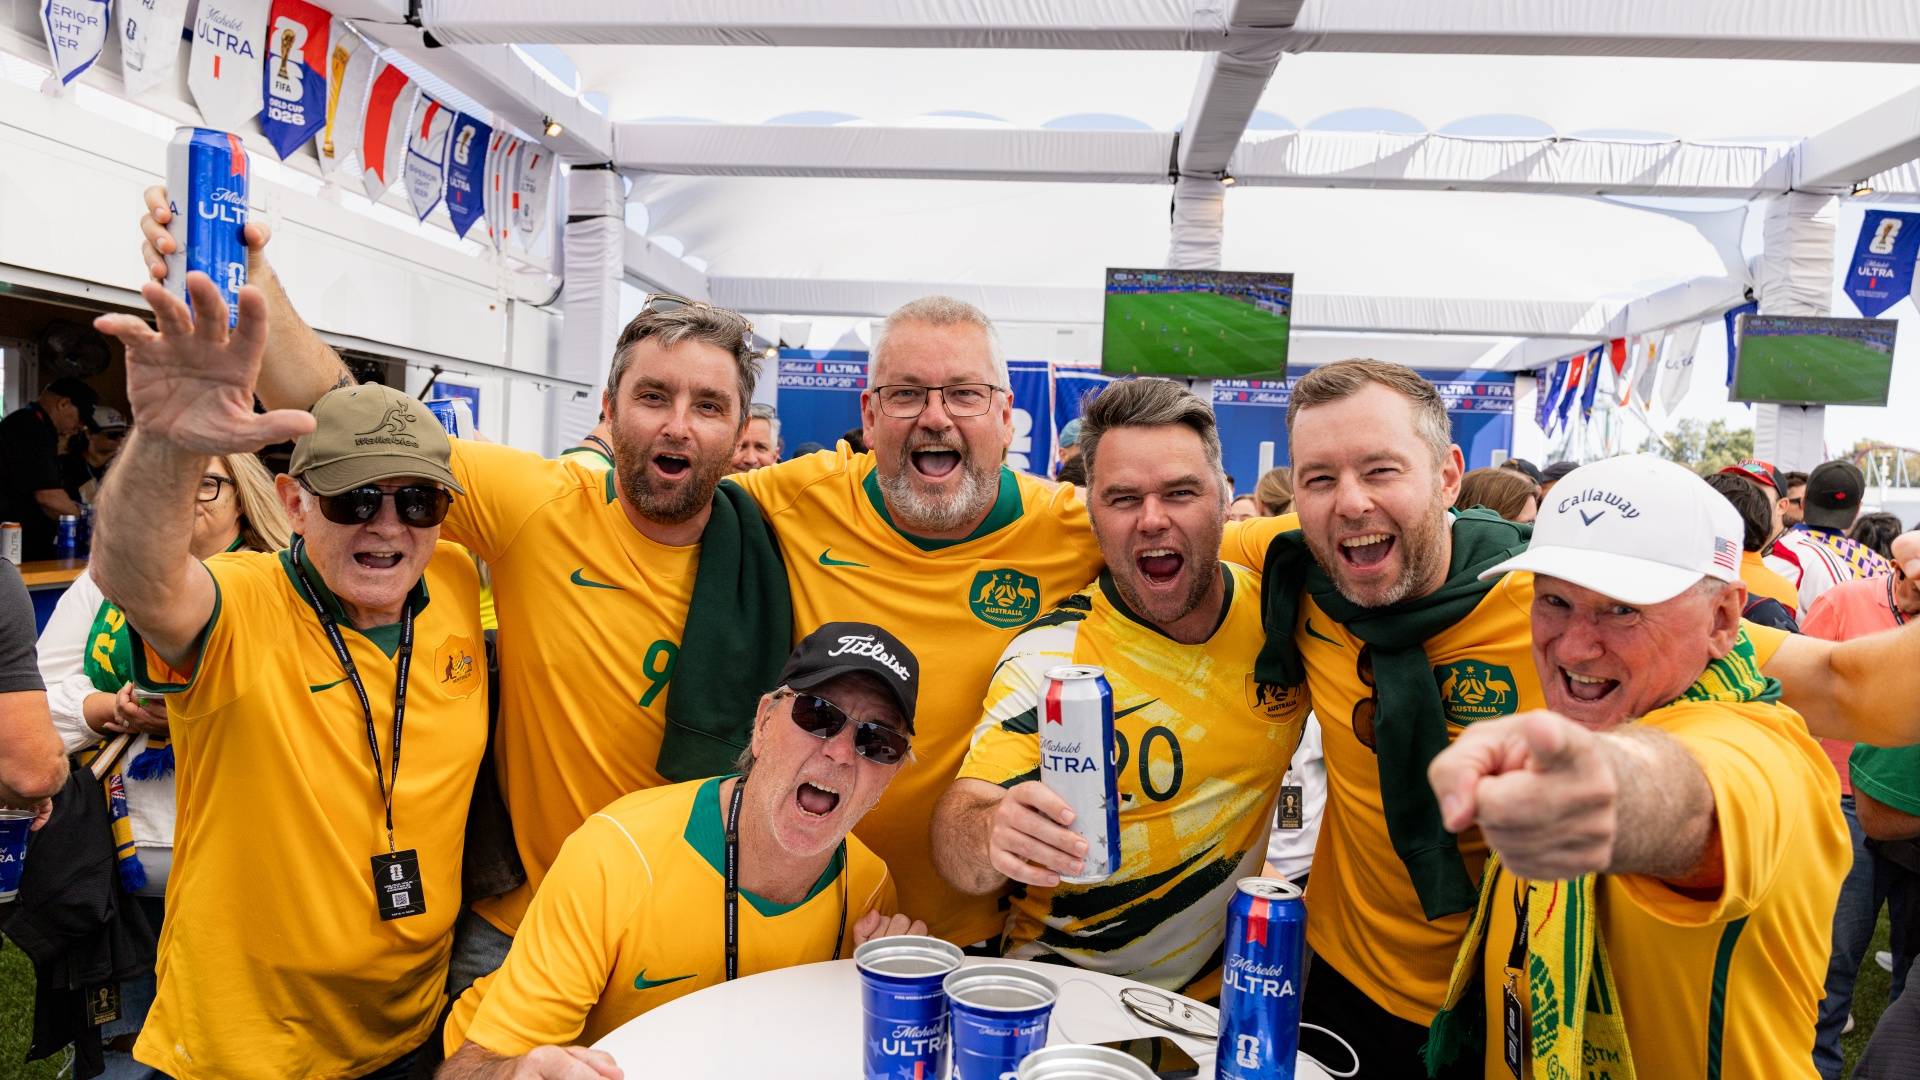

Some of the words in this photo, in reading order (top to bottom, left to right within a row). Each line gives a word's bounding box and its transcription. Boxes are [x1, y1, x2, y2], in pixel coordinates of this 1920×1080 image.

[198, 18, 254, 59] ULTRA
[275, 80, 292, 93] FIFA
[287, 103, 304, 114] CUP
[198, 201, 247, 225] ULT
[1857, 266, 1895, 279] ULTRA
[824, 363, 862, 374] ULTRA
[777, 375, 815, 387] WORLD
[816, 376, 837, 387] CUP
[1435, 384, 1474, 396] ULTRA
[1487, 386, 1512, 397] FIFA
[1558, 488, 1640, 519] Callaway
[985, 606, 1023, 617] AUSTRALIA
[827, 634, 911, 681] Titleist
[639, 639, 680, 708] 9
[1267, 699, 1298, 713] AUSTRALIA
[1451, 705, 1498, 713] AUSTRALIA
[1040, 737, 1081, 754] Michelob
[1041, 753, 1097, 774] LTRA
[1230, 953, 1283, 977] Michelob
[1223, 964, 1295, 998] ULTRA
[882, 1031, 949, 1057] ULTRA
